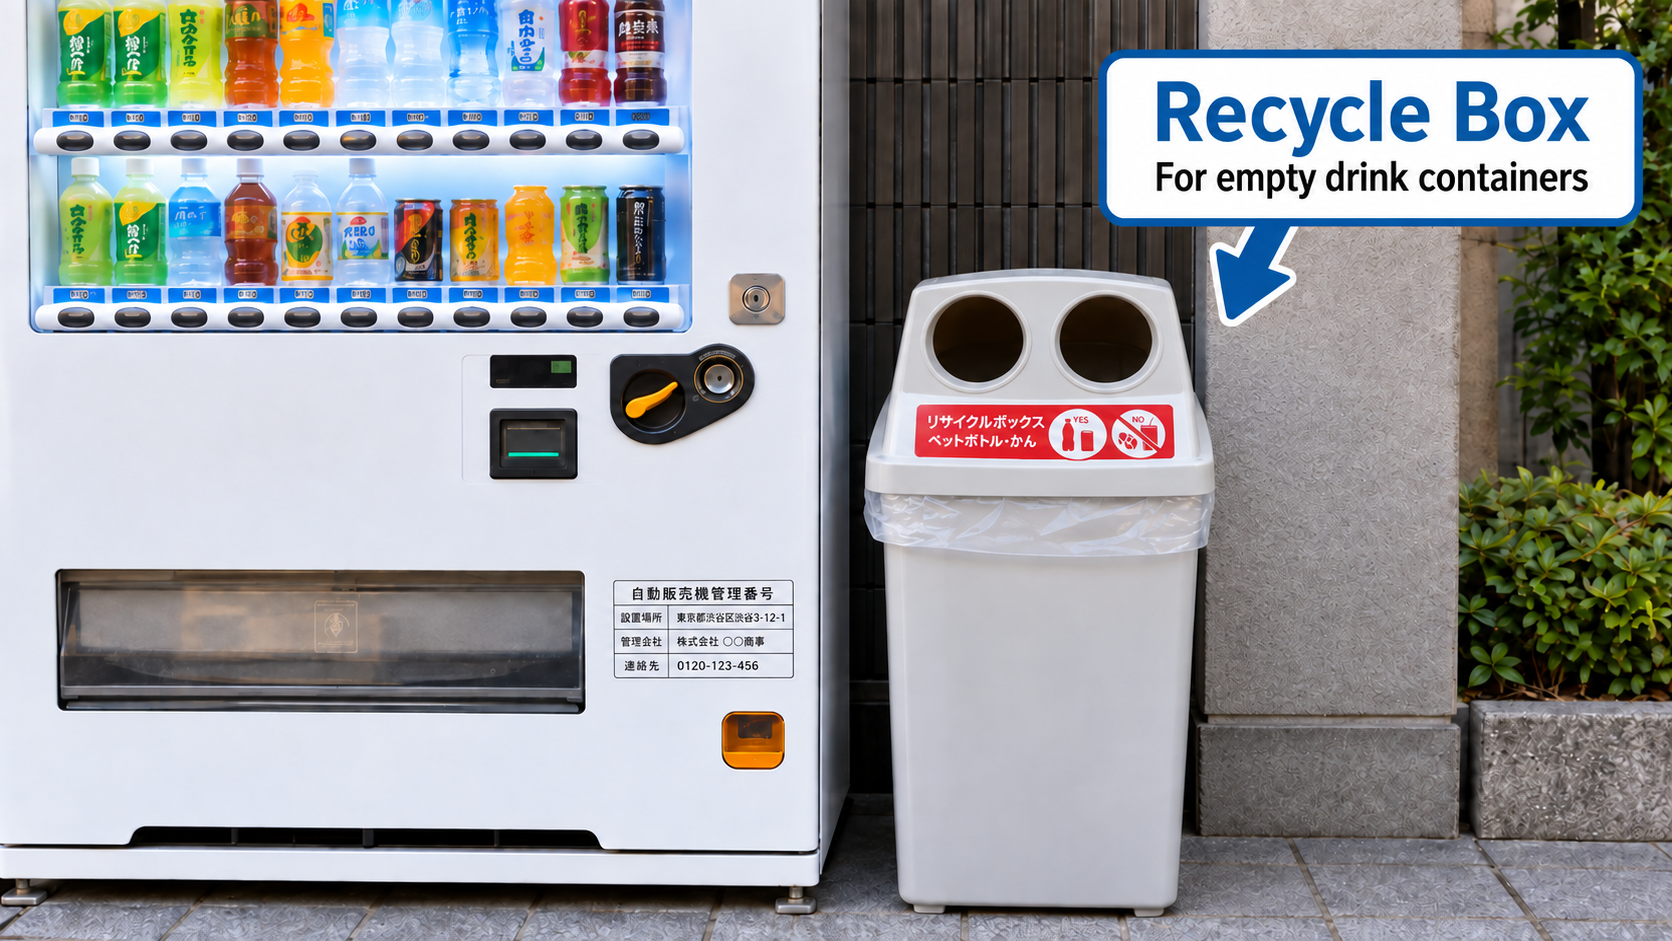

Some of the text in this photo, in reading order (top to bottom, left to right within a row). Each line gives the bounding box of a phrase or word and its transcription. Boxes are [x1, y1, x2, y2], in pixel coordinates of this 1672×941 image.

[927, 414, 1045, 430] リサイクルボックス
[1072, 415, 1089, 424] YES
[1131, 415, 1145, 424] NO
[928, 433, 1037, 448] ペットボトル・かん
[632, 586, 774, 601] 自動販売機管理番号
[620, 635, 663, 647] 管理会社
[676, 635, 720, 647] 株式会社
[676, 660, 759, 671] 0120-123-456
